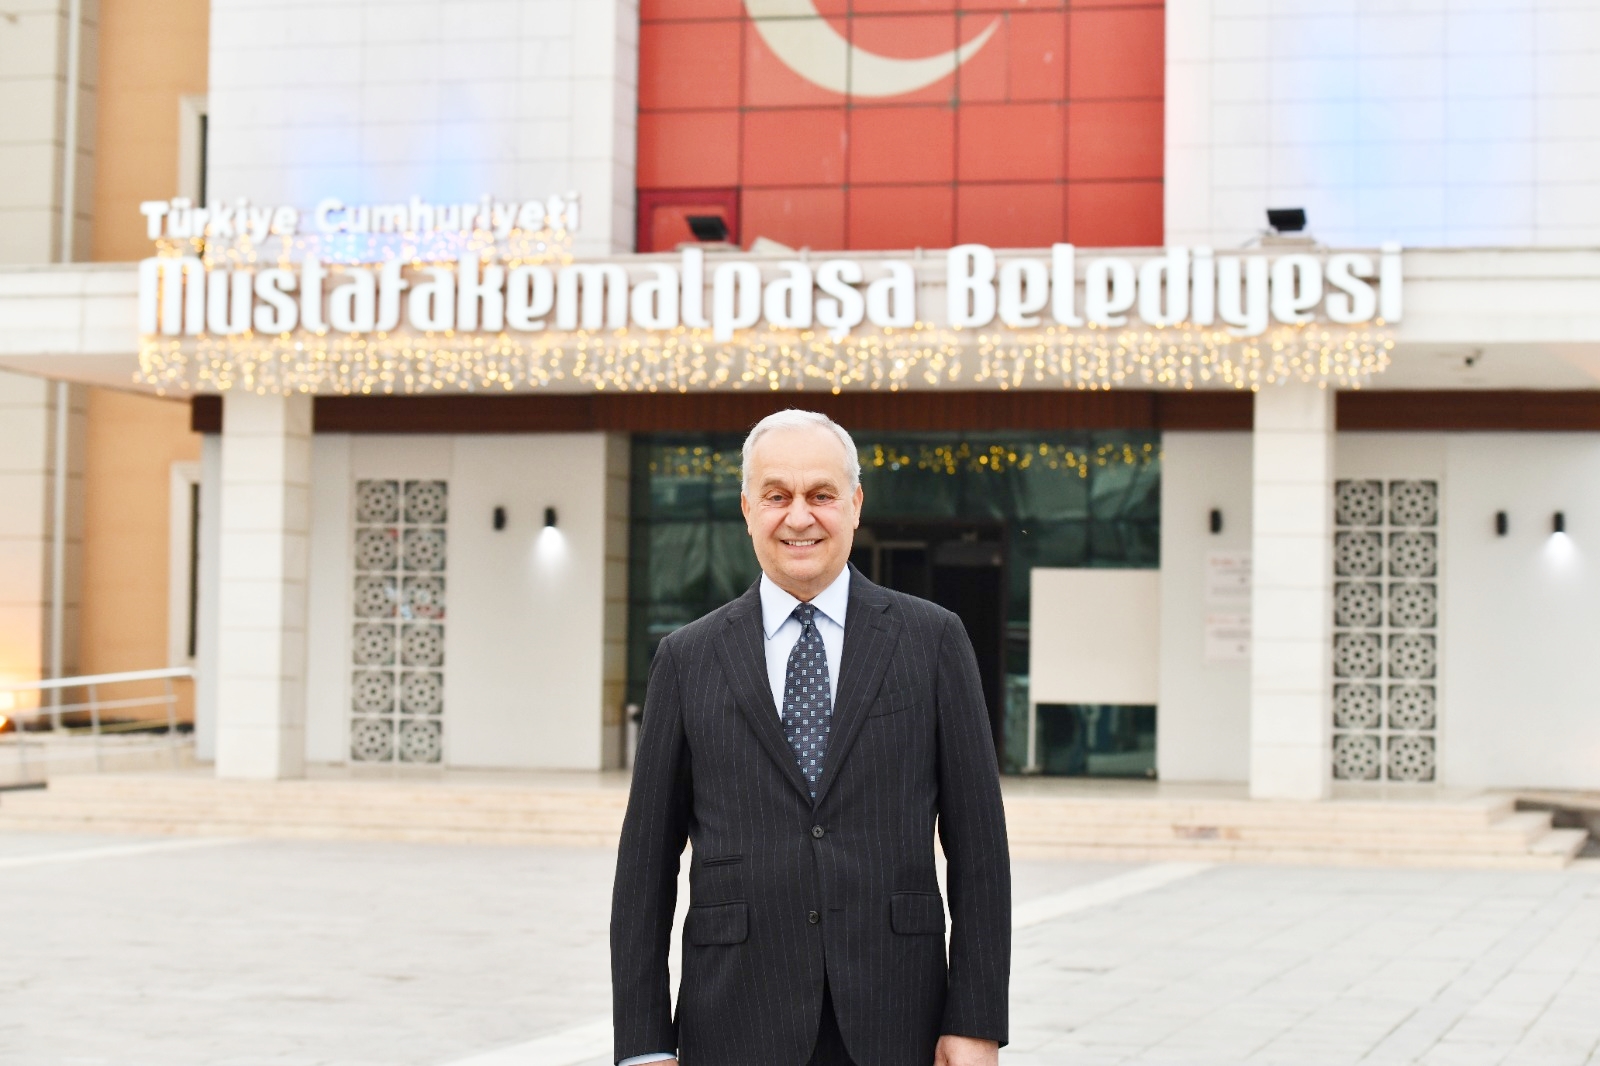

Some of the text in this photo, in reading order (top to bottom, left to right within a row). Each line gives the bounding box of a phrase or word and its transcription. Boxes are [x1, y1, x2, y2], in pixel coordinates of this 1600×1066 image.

[141, 192, 580, 241] Türkiye Cumhuriyeti
[139, 242, 1403, 342] Mustafakemalpaşa Belediyesi
